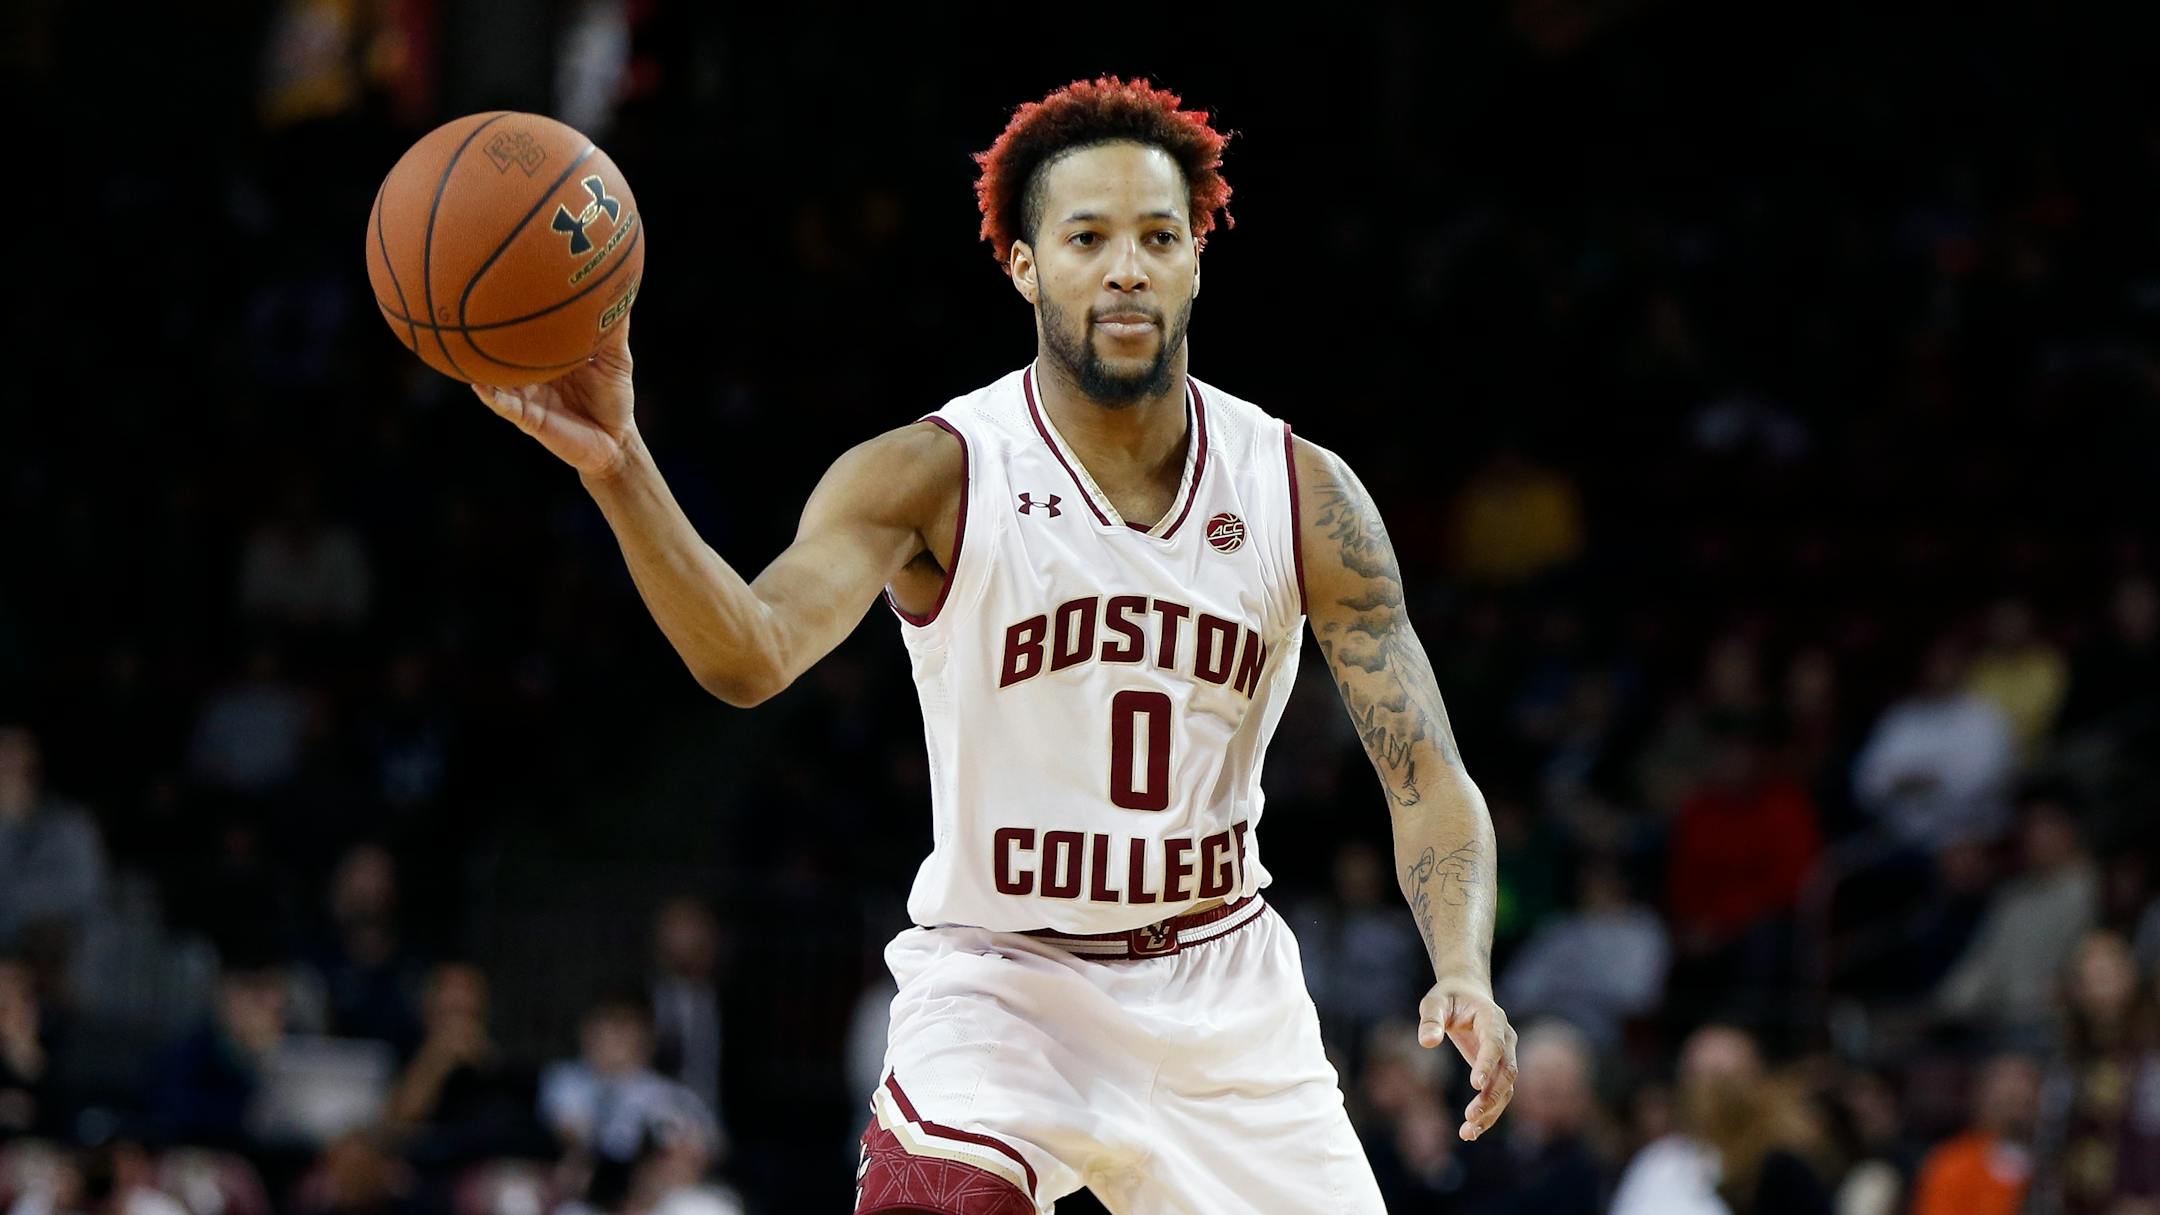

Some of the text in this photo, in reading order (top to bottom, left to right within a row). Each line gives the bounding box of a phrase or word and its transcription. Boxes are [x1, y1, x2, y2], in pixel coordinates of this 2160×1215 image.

[569, 248, 606, 286] UNDER
[1210, 522, 1243, 537] ACC
[998, 594, 1267, 700] BOSTON
[1110, 690, 1172, 812] 0
